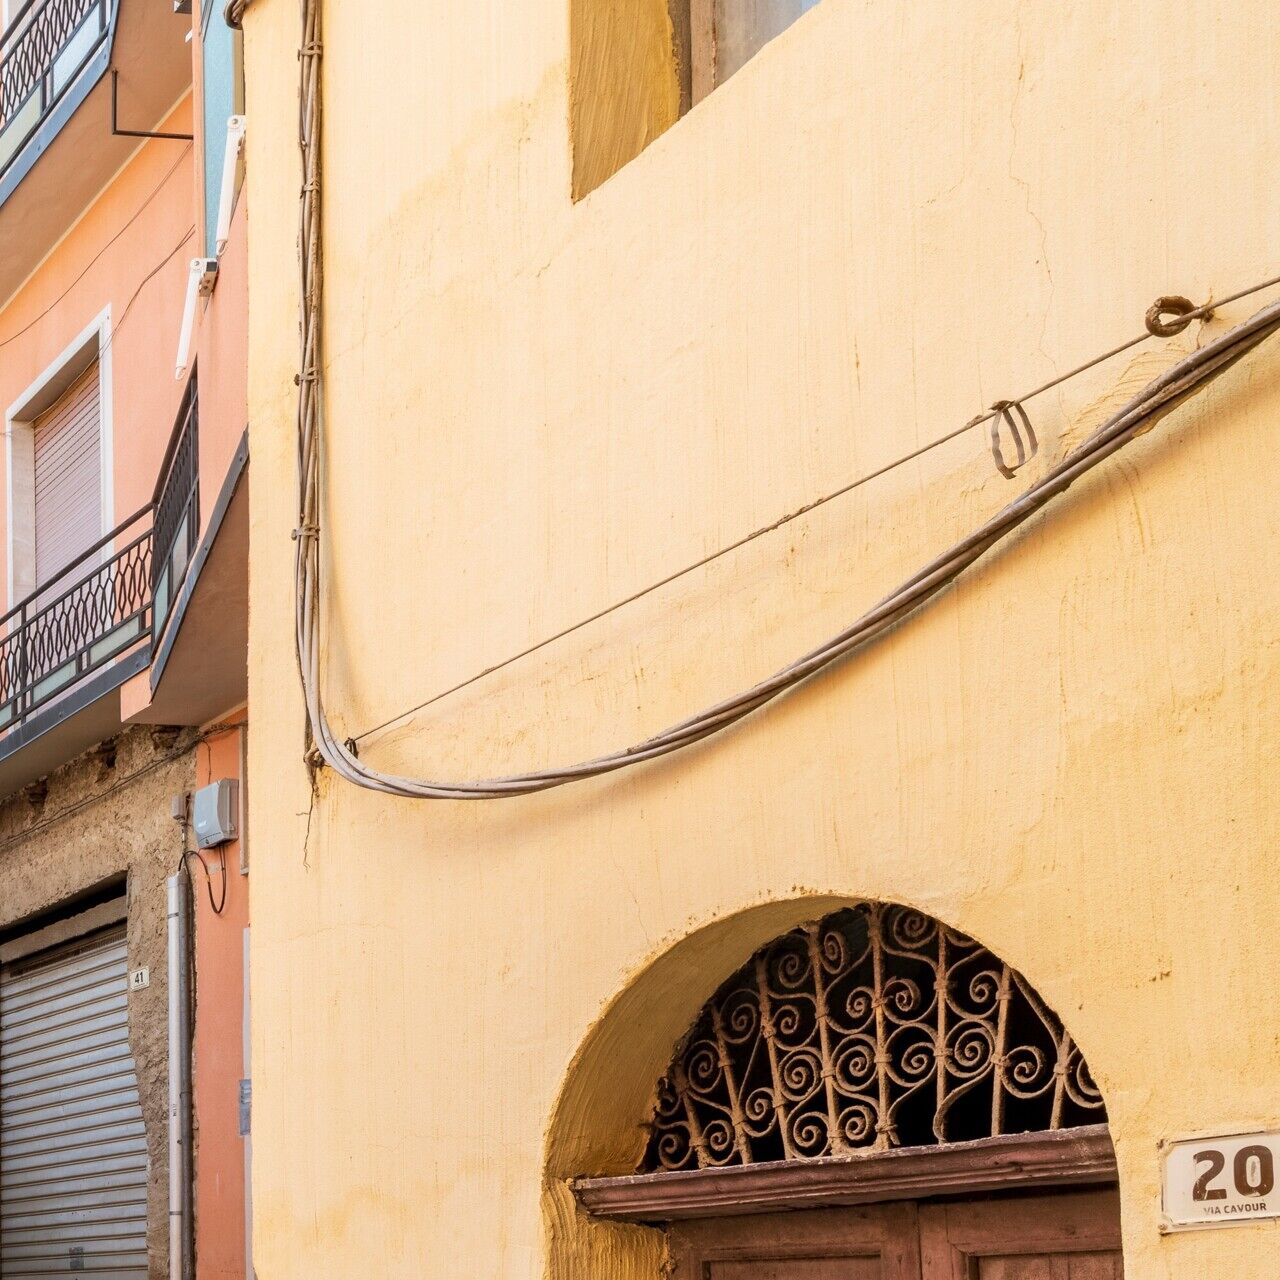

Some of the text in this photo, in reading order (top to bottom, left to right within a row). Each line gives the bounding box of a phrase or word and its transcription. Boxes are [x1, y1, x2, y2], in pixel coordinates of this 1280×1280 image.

[134, 971, 144, 983] 41
[1192, 1144, 1274, 1201] 20
[1204, 1202, 1267, 1215] VIA CAVOUR
